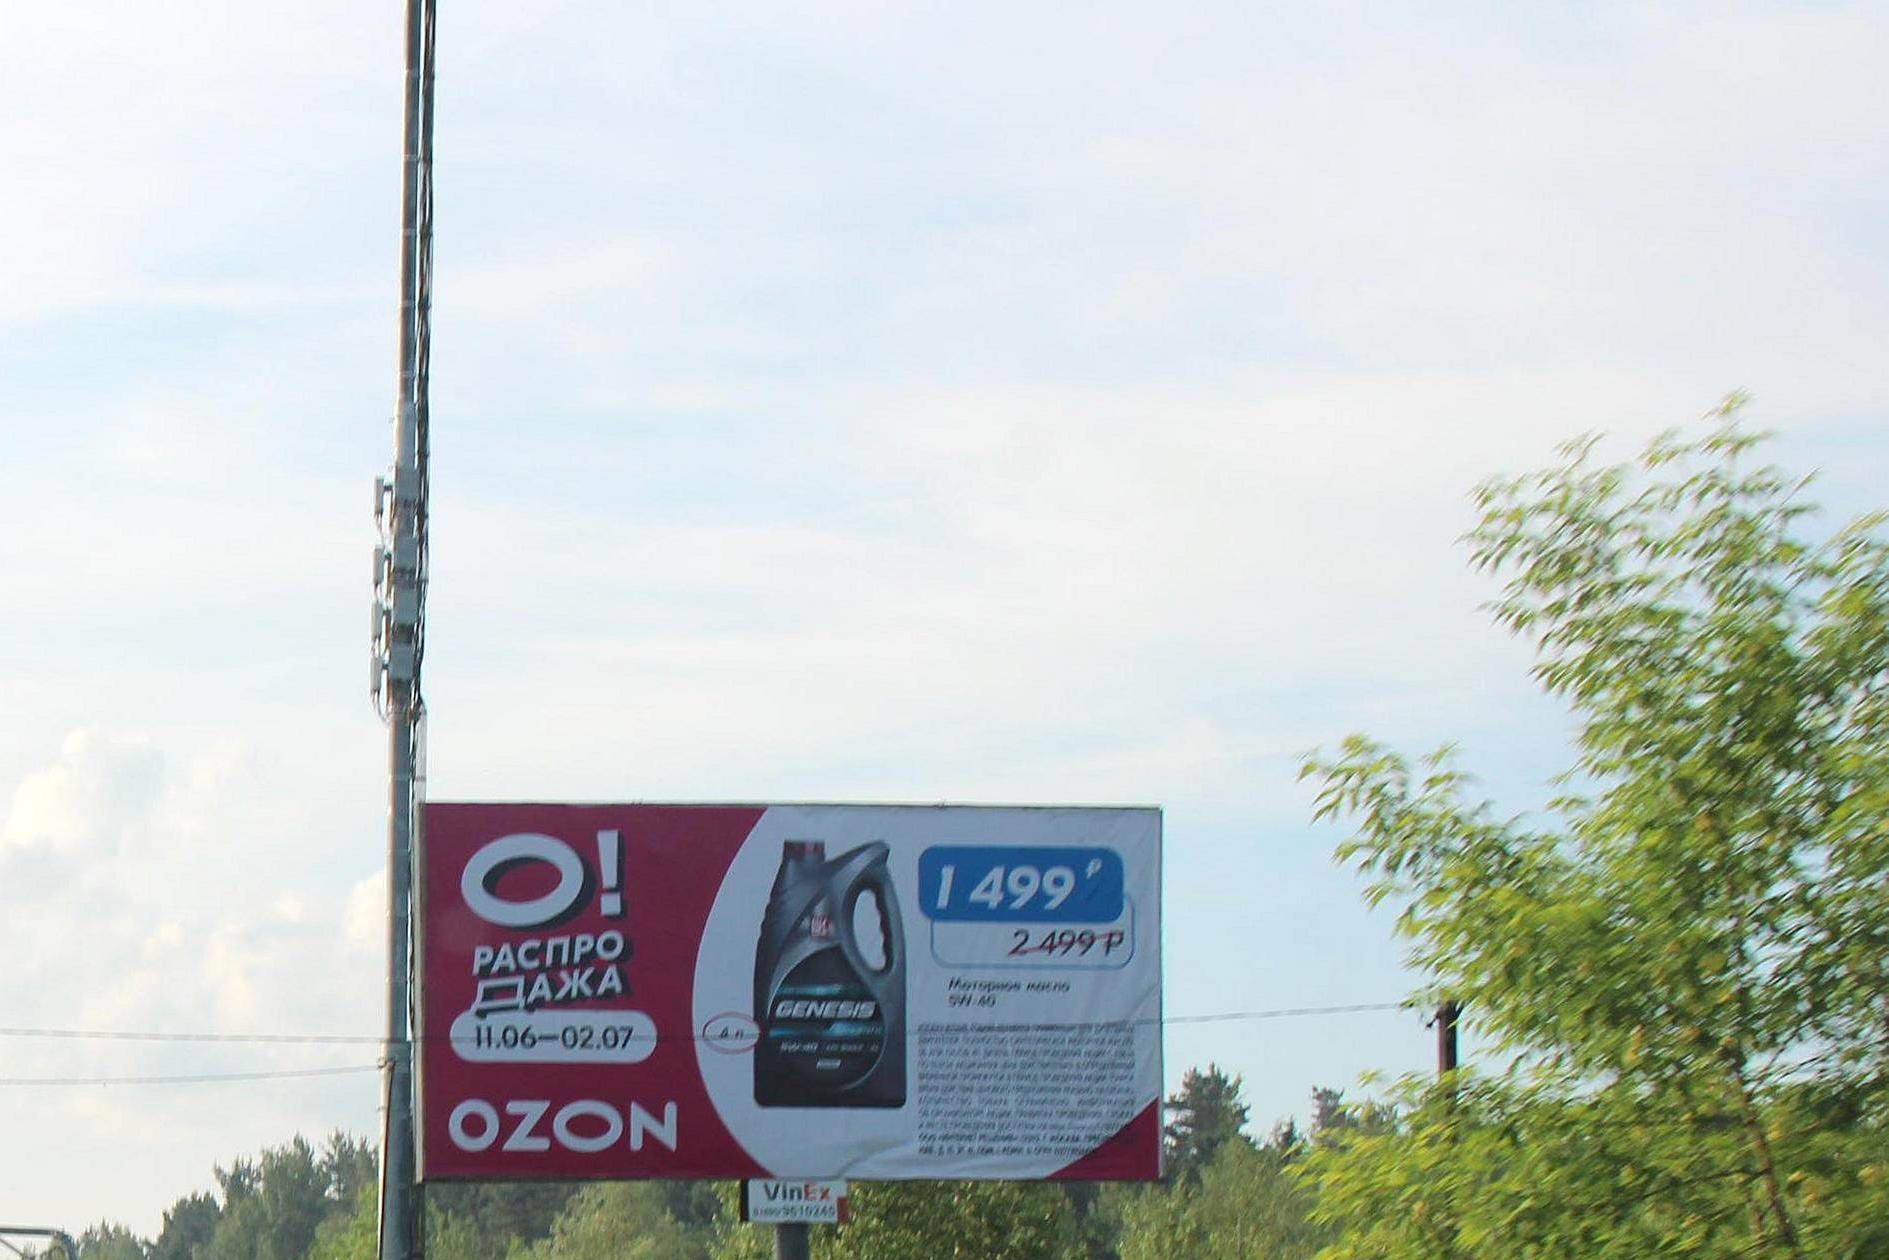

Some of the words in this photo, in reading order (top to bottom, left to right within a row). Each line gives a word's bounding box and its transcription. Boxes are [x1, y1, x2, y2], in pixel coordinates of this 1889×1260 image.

[969, 864, 1076, 911] 499
[472, 929, 624, 976] РАСПРО
[469, 964, 623, 1014] ДАЖА
[775, 1000, 877, 1020] GENESIS
[448, 1099, 678, 1153] OZON
[764, 1182, 830, 1200] VinEx
